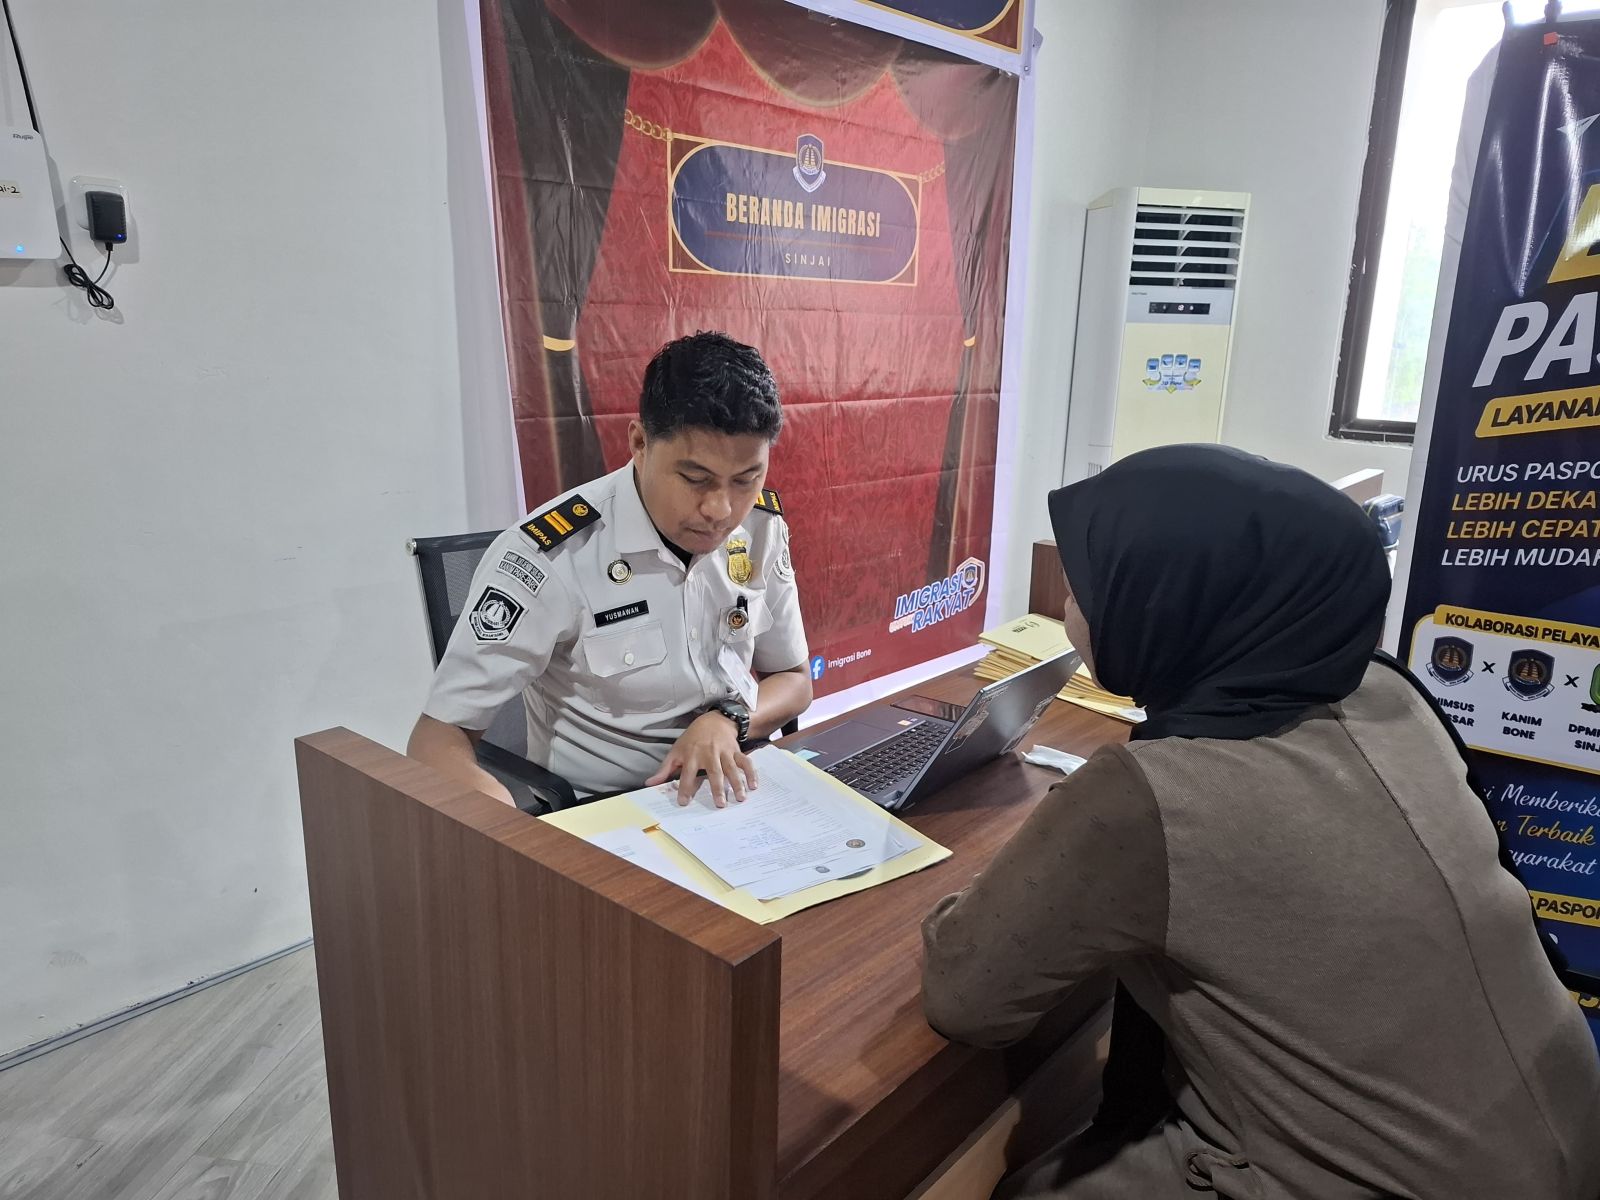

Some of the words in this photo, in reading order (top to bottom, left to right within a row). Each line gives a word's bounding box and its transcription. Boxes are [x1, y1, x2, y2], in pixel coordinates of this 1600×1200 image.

[726, 193, 804, 230] BERANDA
[811, 204, 880, 238] IMIGRASI
[785, 253, 831, 267] SINJAI
[1472, 291, 1600, 389] PA
[1457, 464, 1519, 483] URUS
[1452, 492, 1520, 511] LEBIH
[527, 523, 551, 545] IMIPAS
[1446, 520, 1516, 539] LEBIH
[1441, 549, 1510, 566] LEBIH
[895, 571, 964, 619] IMIGRASI
[605, 606, 639, 621] YUSMAWAN
[911, 588, 974, 633] RAKYAT
[1445, 612, 1539, 639] KOLABORASI
[1541, 627, 1600, 648] PELAYA
[856, 649, 872, 660] Bone
[1501, 711, 1543, 727] KANIM
[1502, 726, 1536, 740] BONE
[1517, 815, 1596, 846] Terbaik
